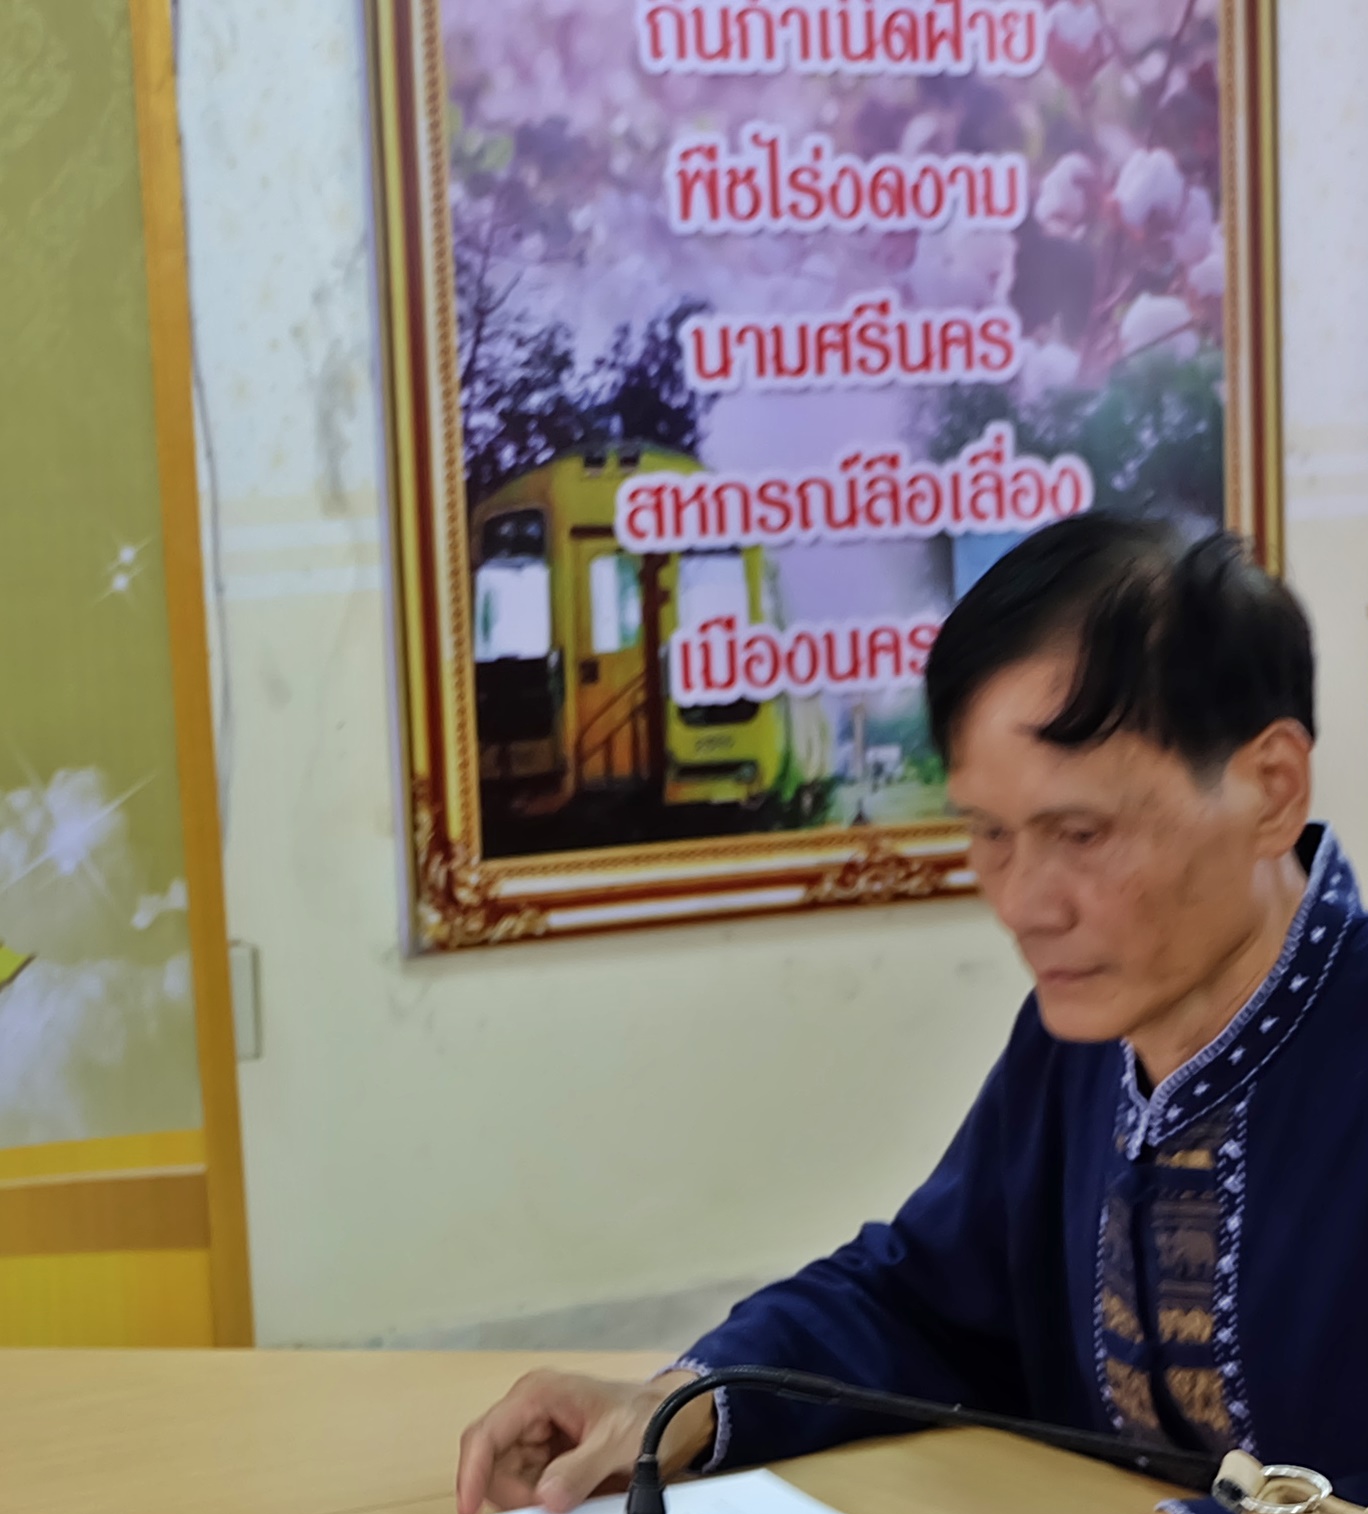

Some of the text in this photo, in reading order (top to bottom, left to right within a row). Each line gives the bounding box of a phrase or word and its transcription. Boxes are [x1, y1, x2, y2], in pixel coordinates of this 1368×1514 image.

[676, 133, 1019, 221] พืชไร่งดงาม
[691, 299, 1015, 380] นามศรีนคร
[625, 433, 1084, 540] สหกรณ์ลือเลื่อง
